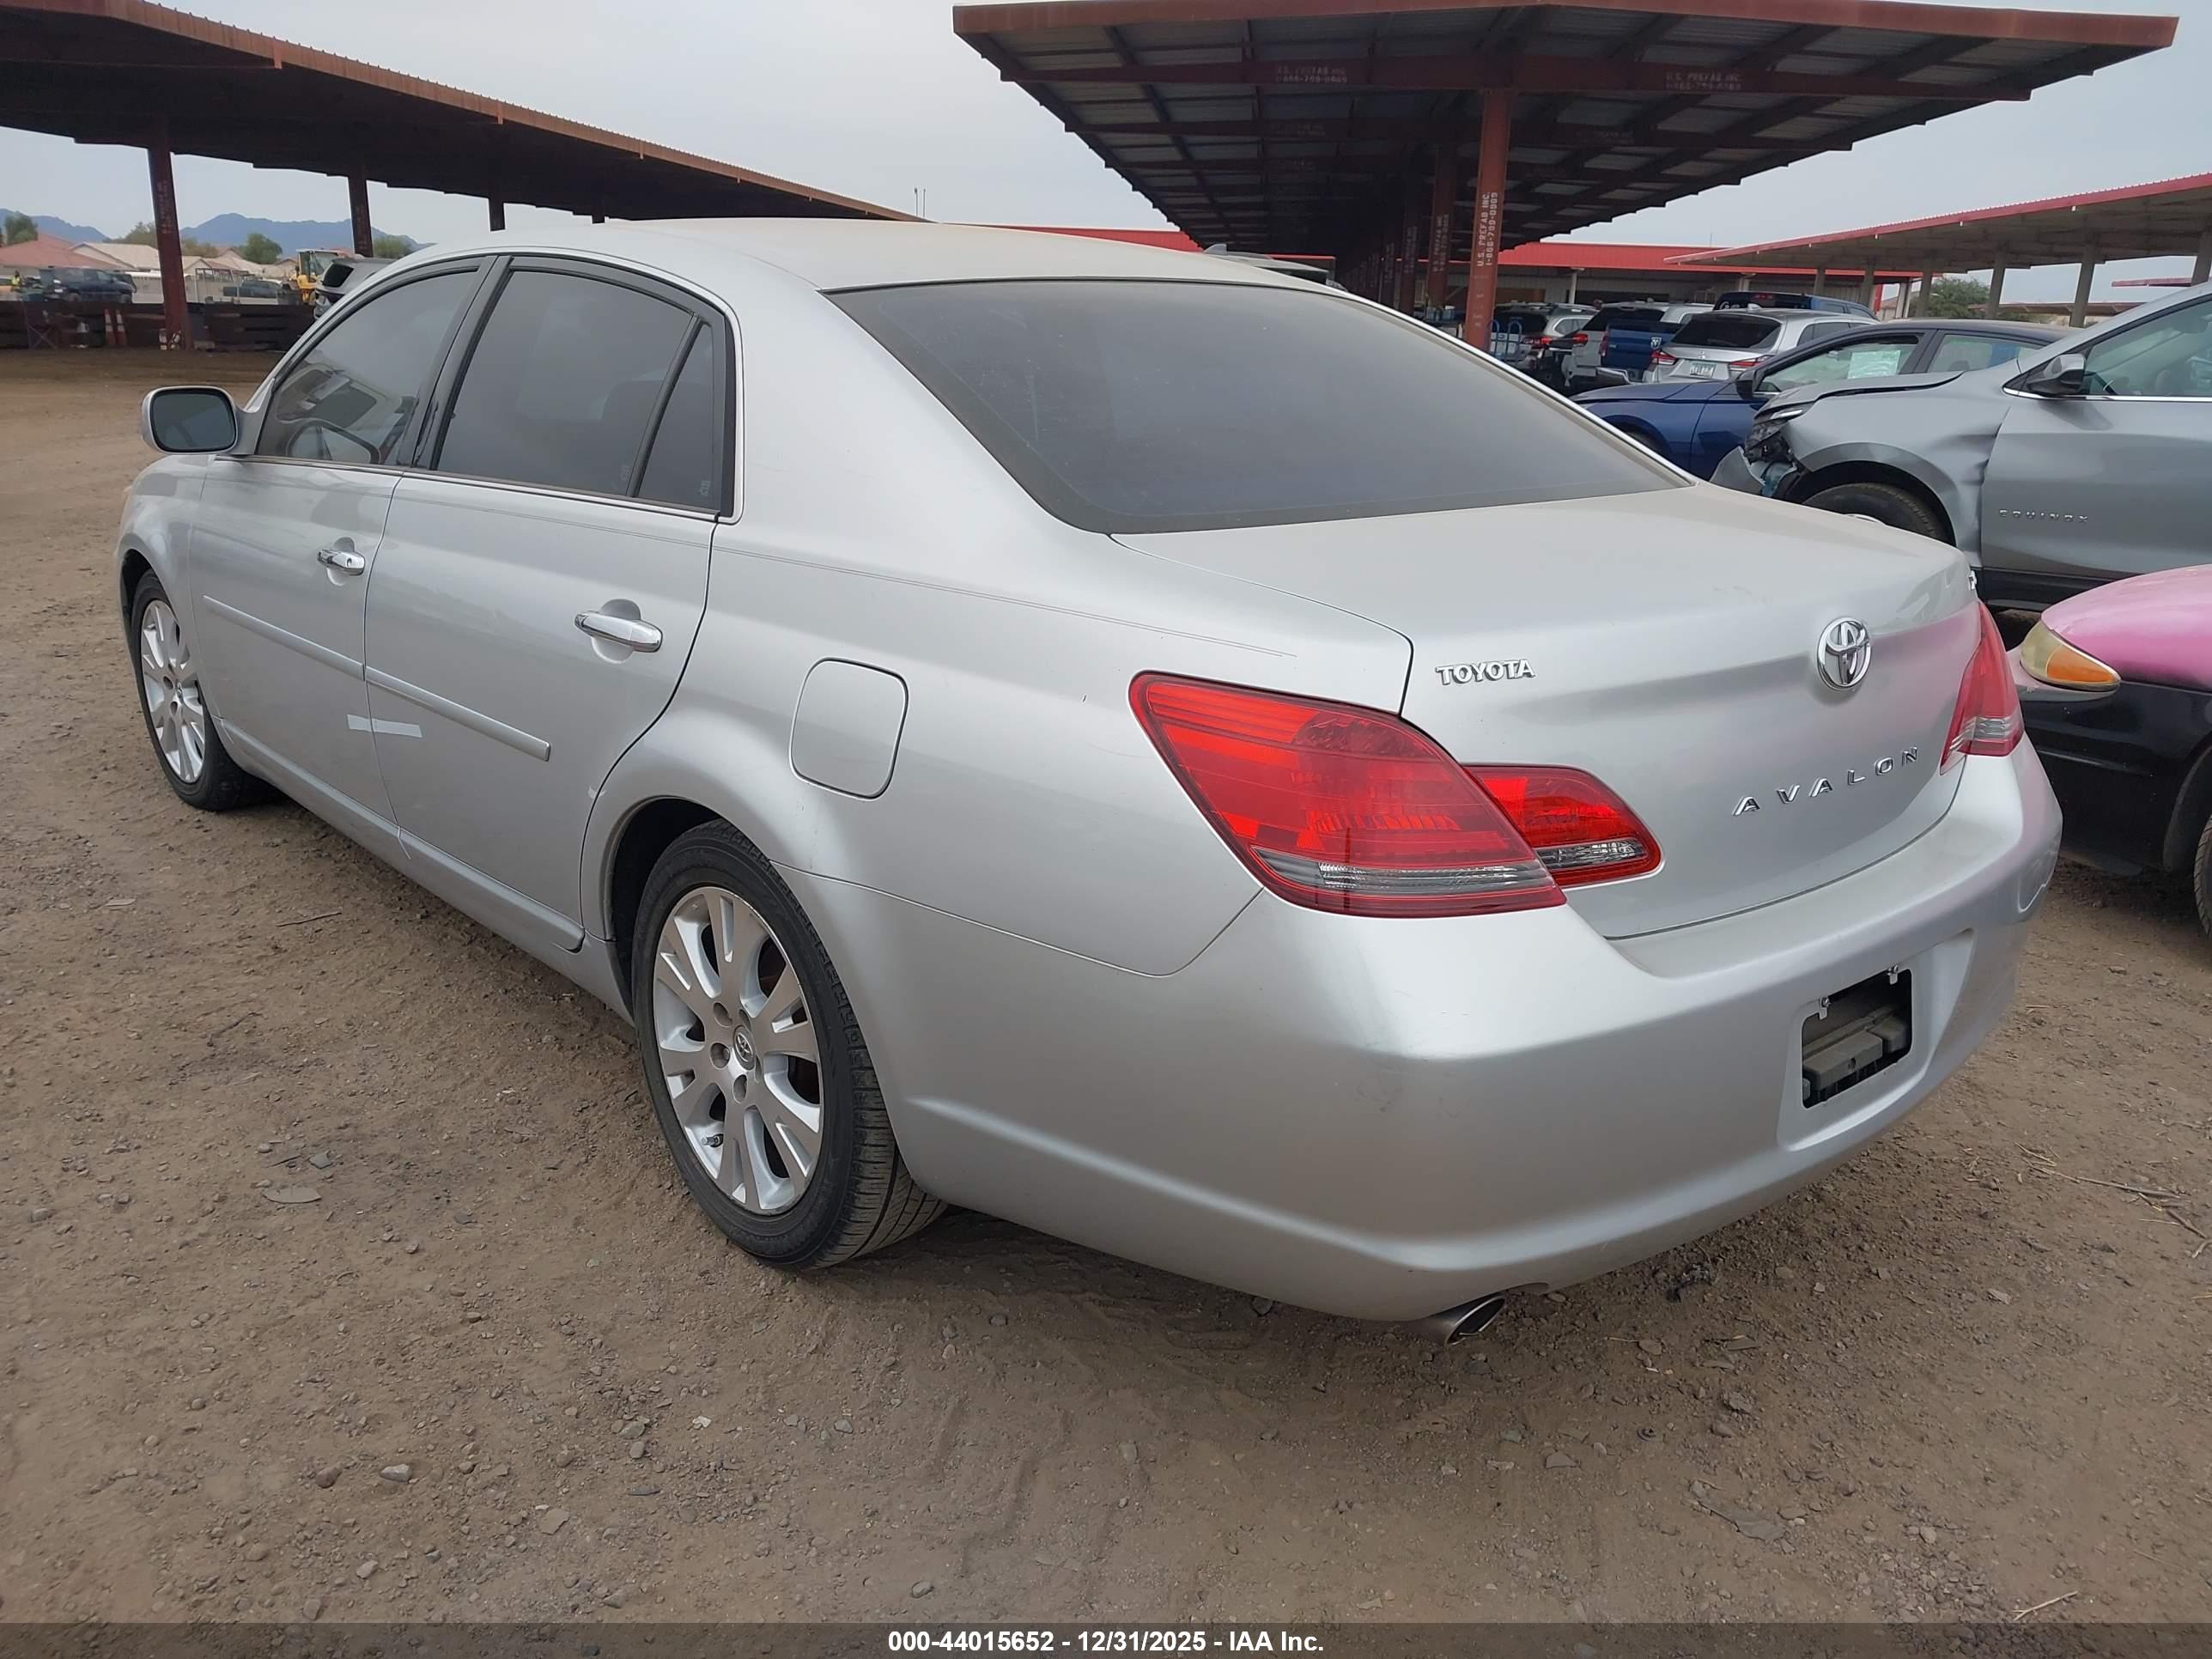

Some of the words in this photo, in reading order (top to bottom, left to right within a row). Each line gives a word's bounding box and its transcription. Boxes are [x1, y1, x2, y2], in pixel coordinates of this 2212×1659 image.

[1478, 212, 1488, 246] PREFAB
[1999, 509, 2088, 523] EQUINOX
[1435, 659, 1536, 686] TOYOTA
[1732, 746, 1918, 817] AVALON
